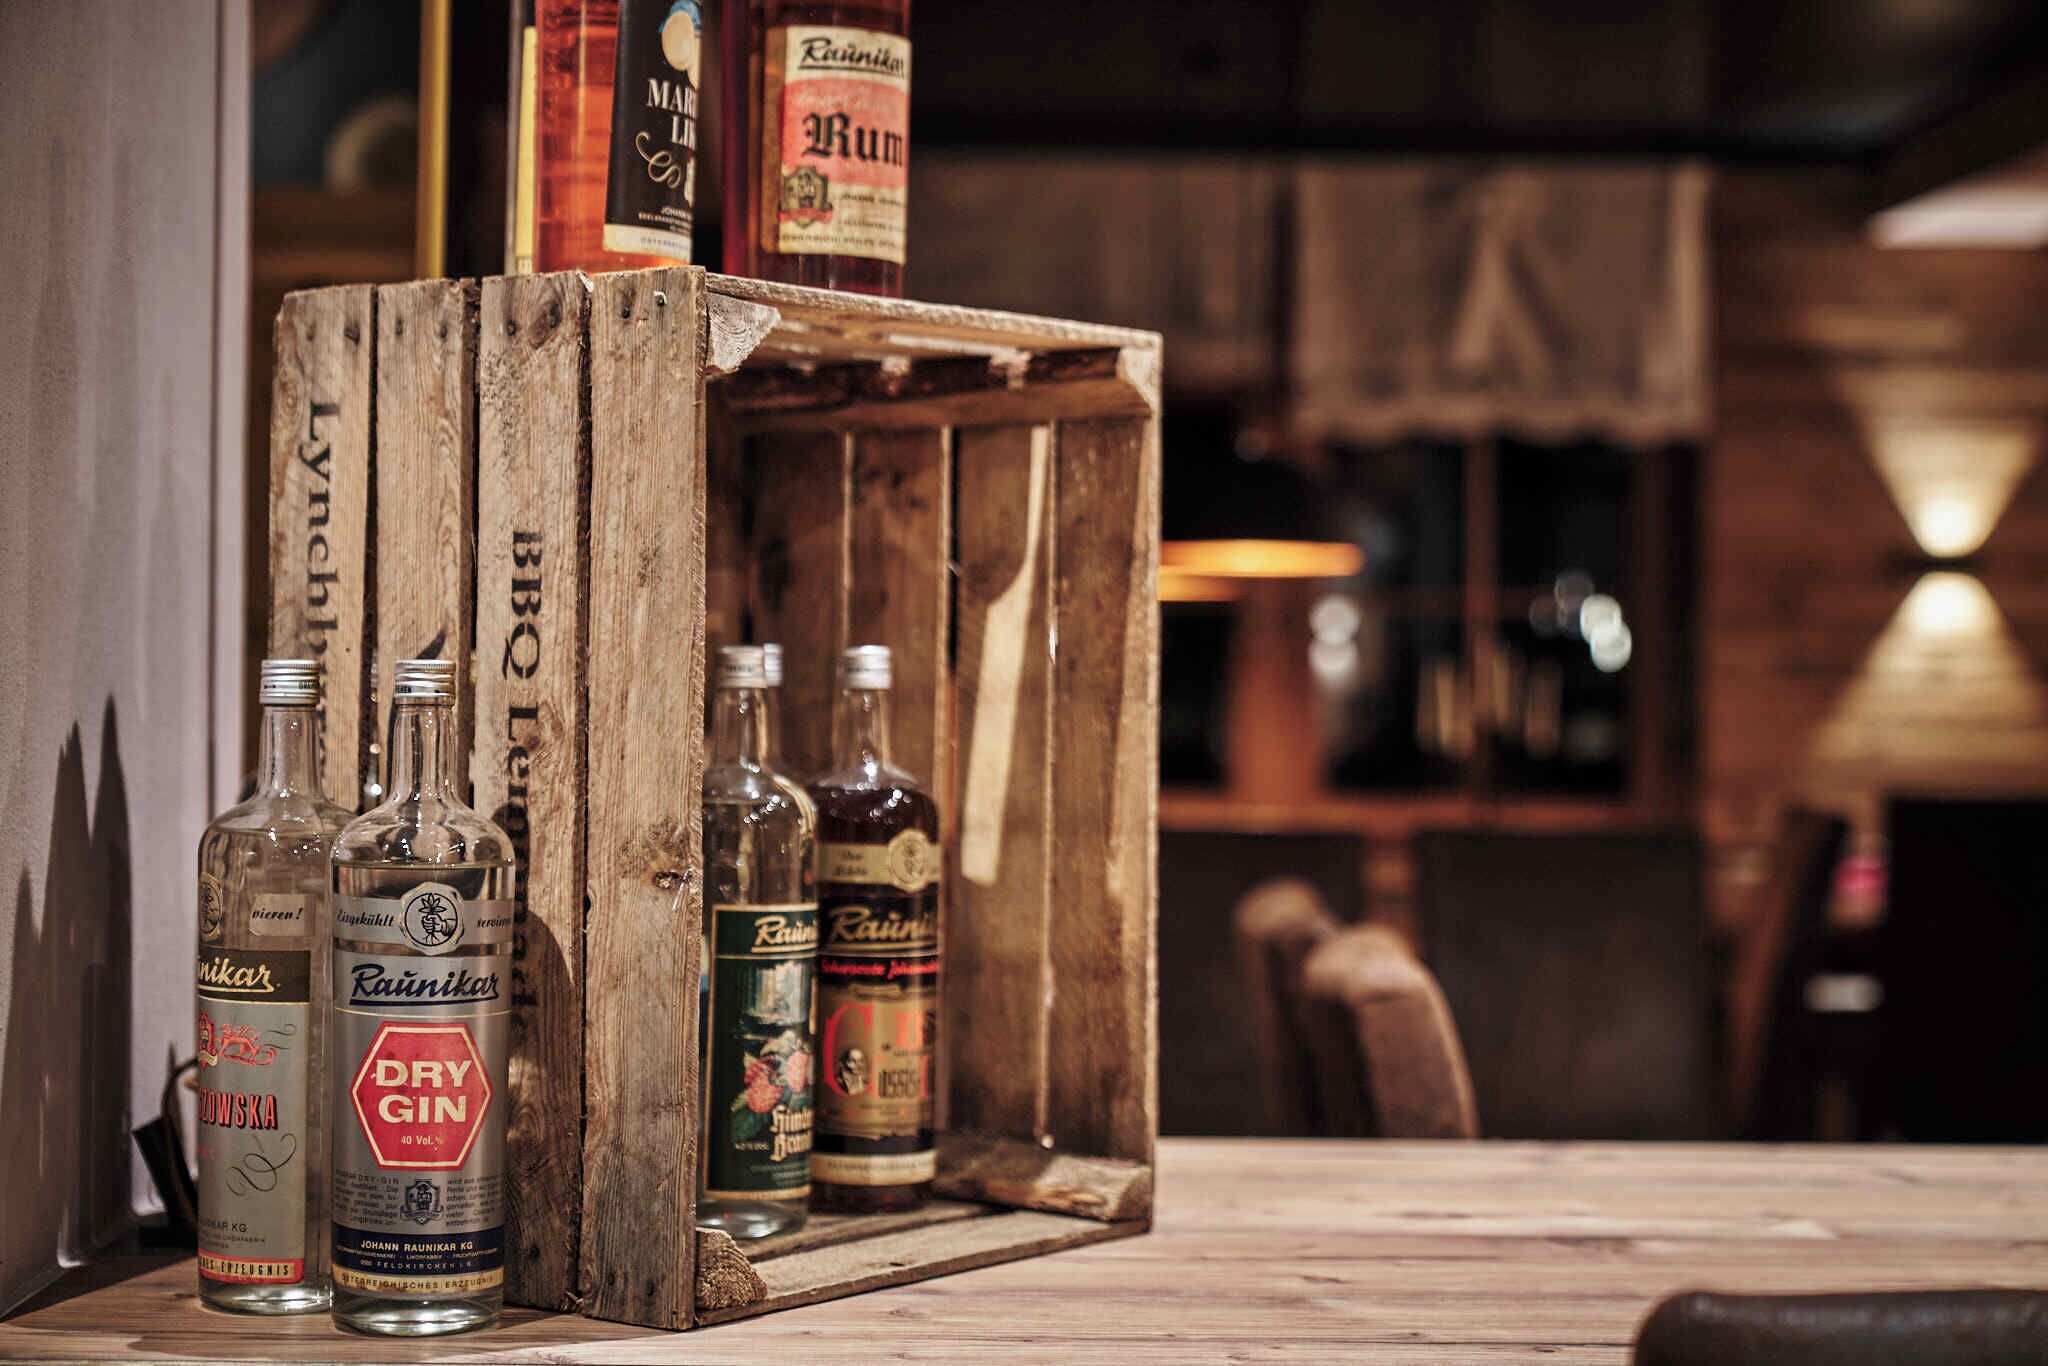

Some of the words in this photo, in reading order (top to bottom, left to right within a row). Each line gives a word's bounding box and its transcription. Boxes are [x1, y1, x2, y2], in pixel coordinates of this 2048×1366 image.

[802, 111, 903, 166] Rum
[502, 531, 543, 680] BBQ
[375, 1059, 472, 1088] DRY
[378, 1094, 467, 1124] GIN
[400, 1135, 412, 1145] 40
[361, 1240, 399, 1252] JOHANN
[404, 1243, 456, 1252] RAUNIKAR
[461, 1241, 473, 1250] KG
